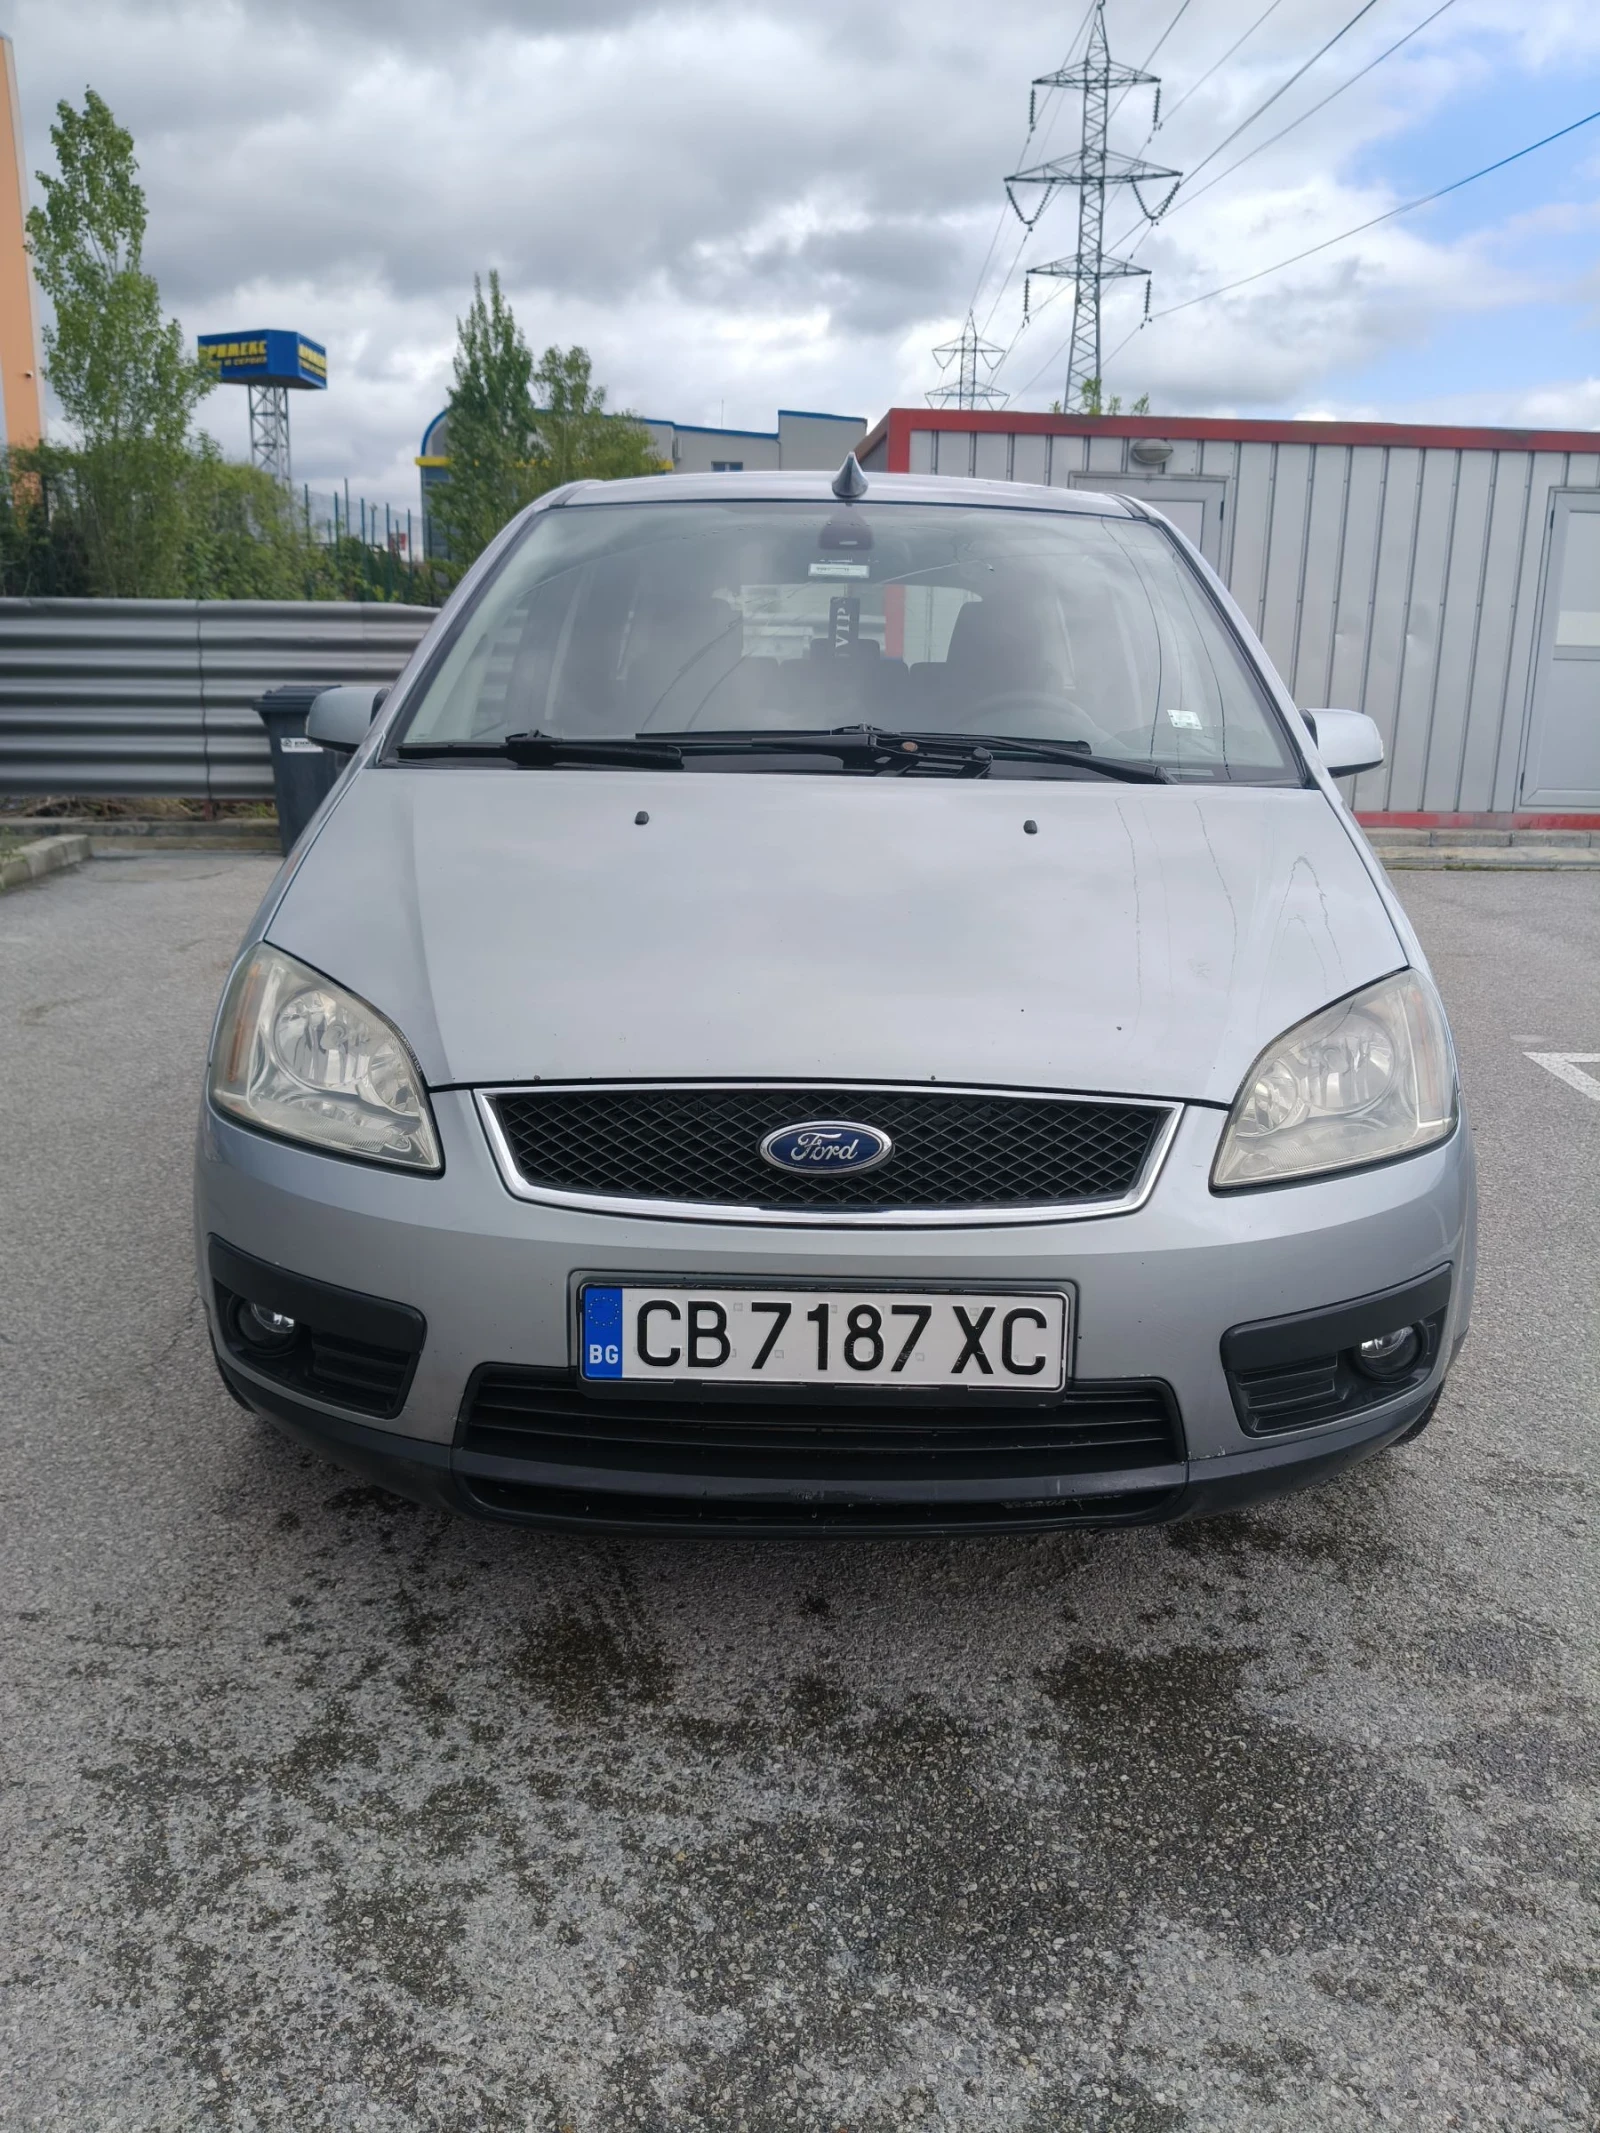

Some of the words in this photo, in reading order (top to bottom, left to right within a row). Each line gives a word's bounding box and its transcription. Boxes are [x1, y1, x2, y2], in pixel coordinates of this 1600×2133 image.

[835, 607, 851, 648] VIP
[790, 1132, 860, 1161] Ford
[589, 1344, 619, 1365] BG
[751, 1302, 932, 1373] 7187
